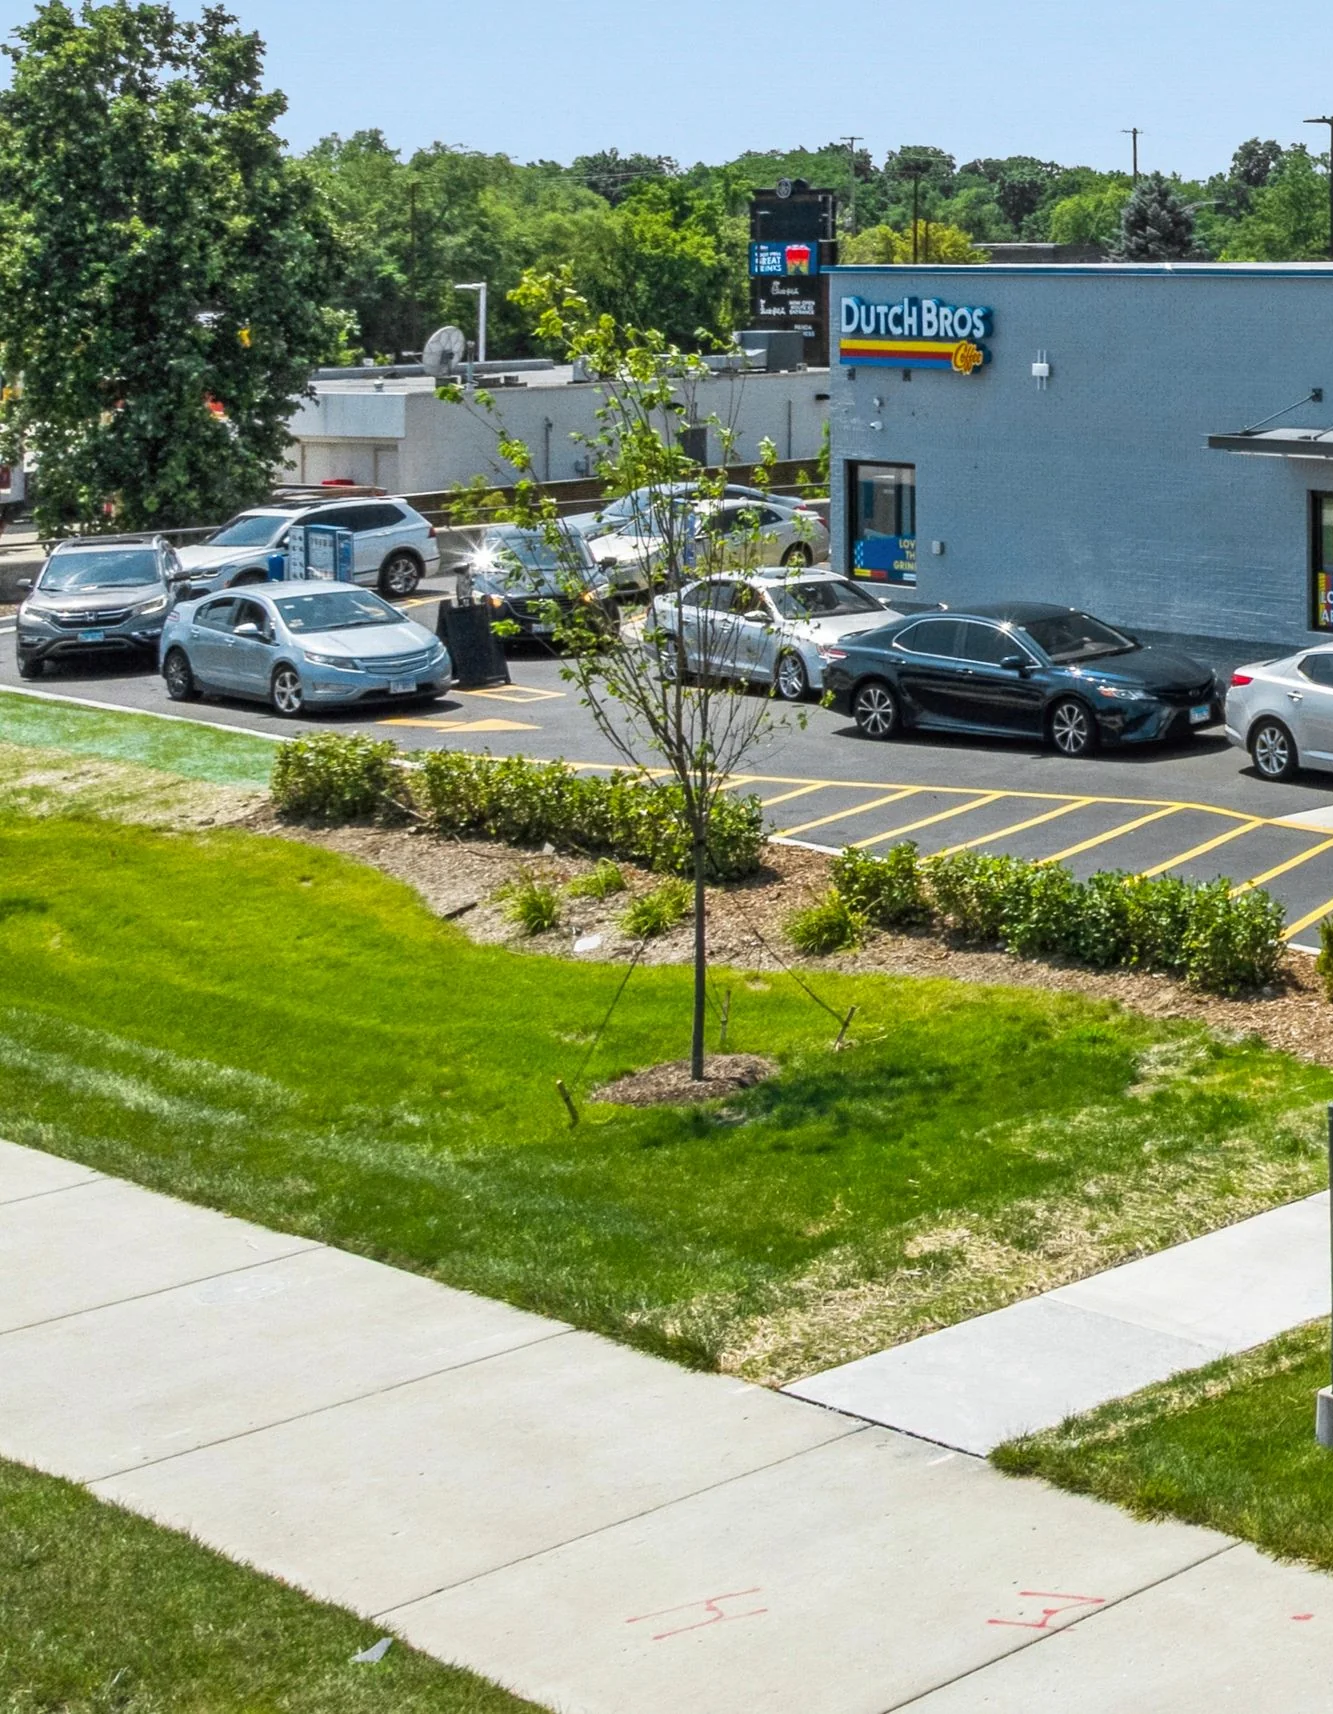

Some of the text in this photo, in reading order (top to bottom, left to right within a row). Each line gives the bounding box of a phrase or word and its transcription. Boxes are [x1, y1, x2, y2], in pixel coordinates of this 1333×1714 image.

[840, 297, 985, 339] DUTCH BROS
[893, 560, 917, 571] GRIN
